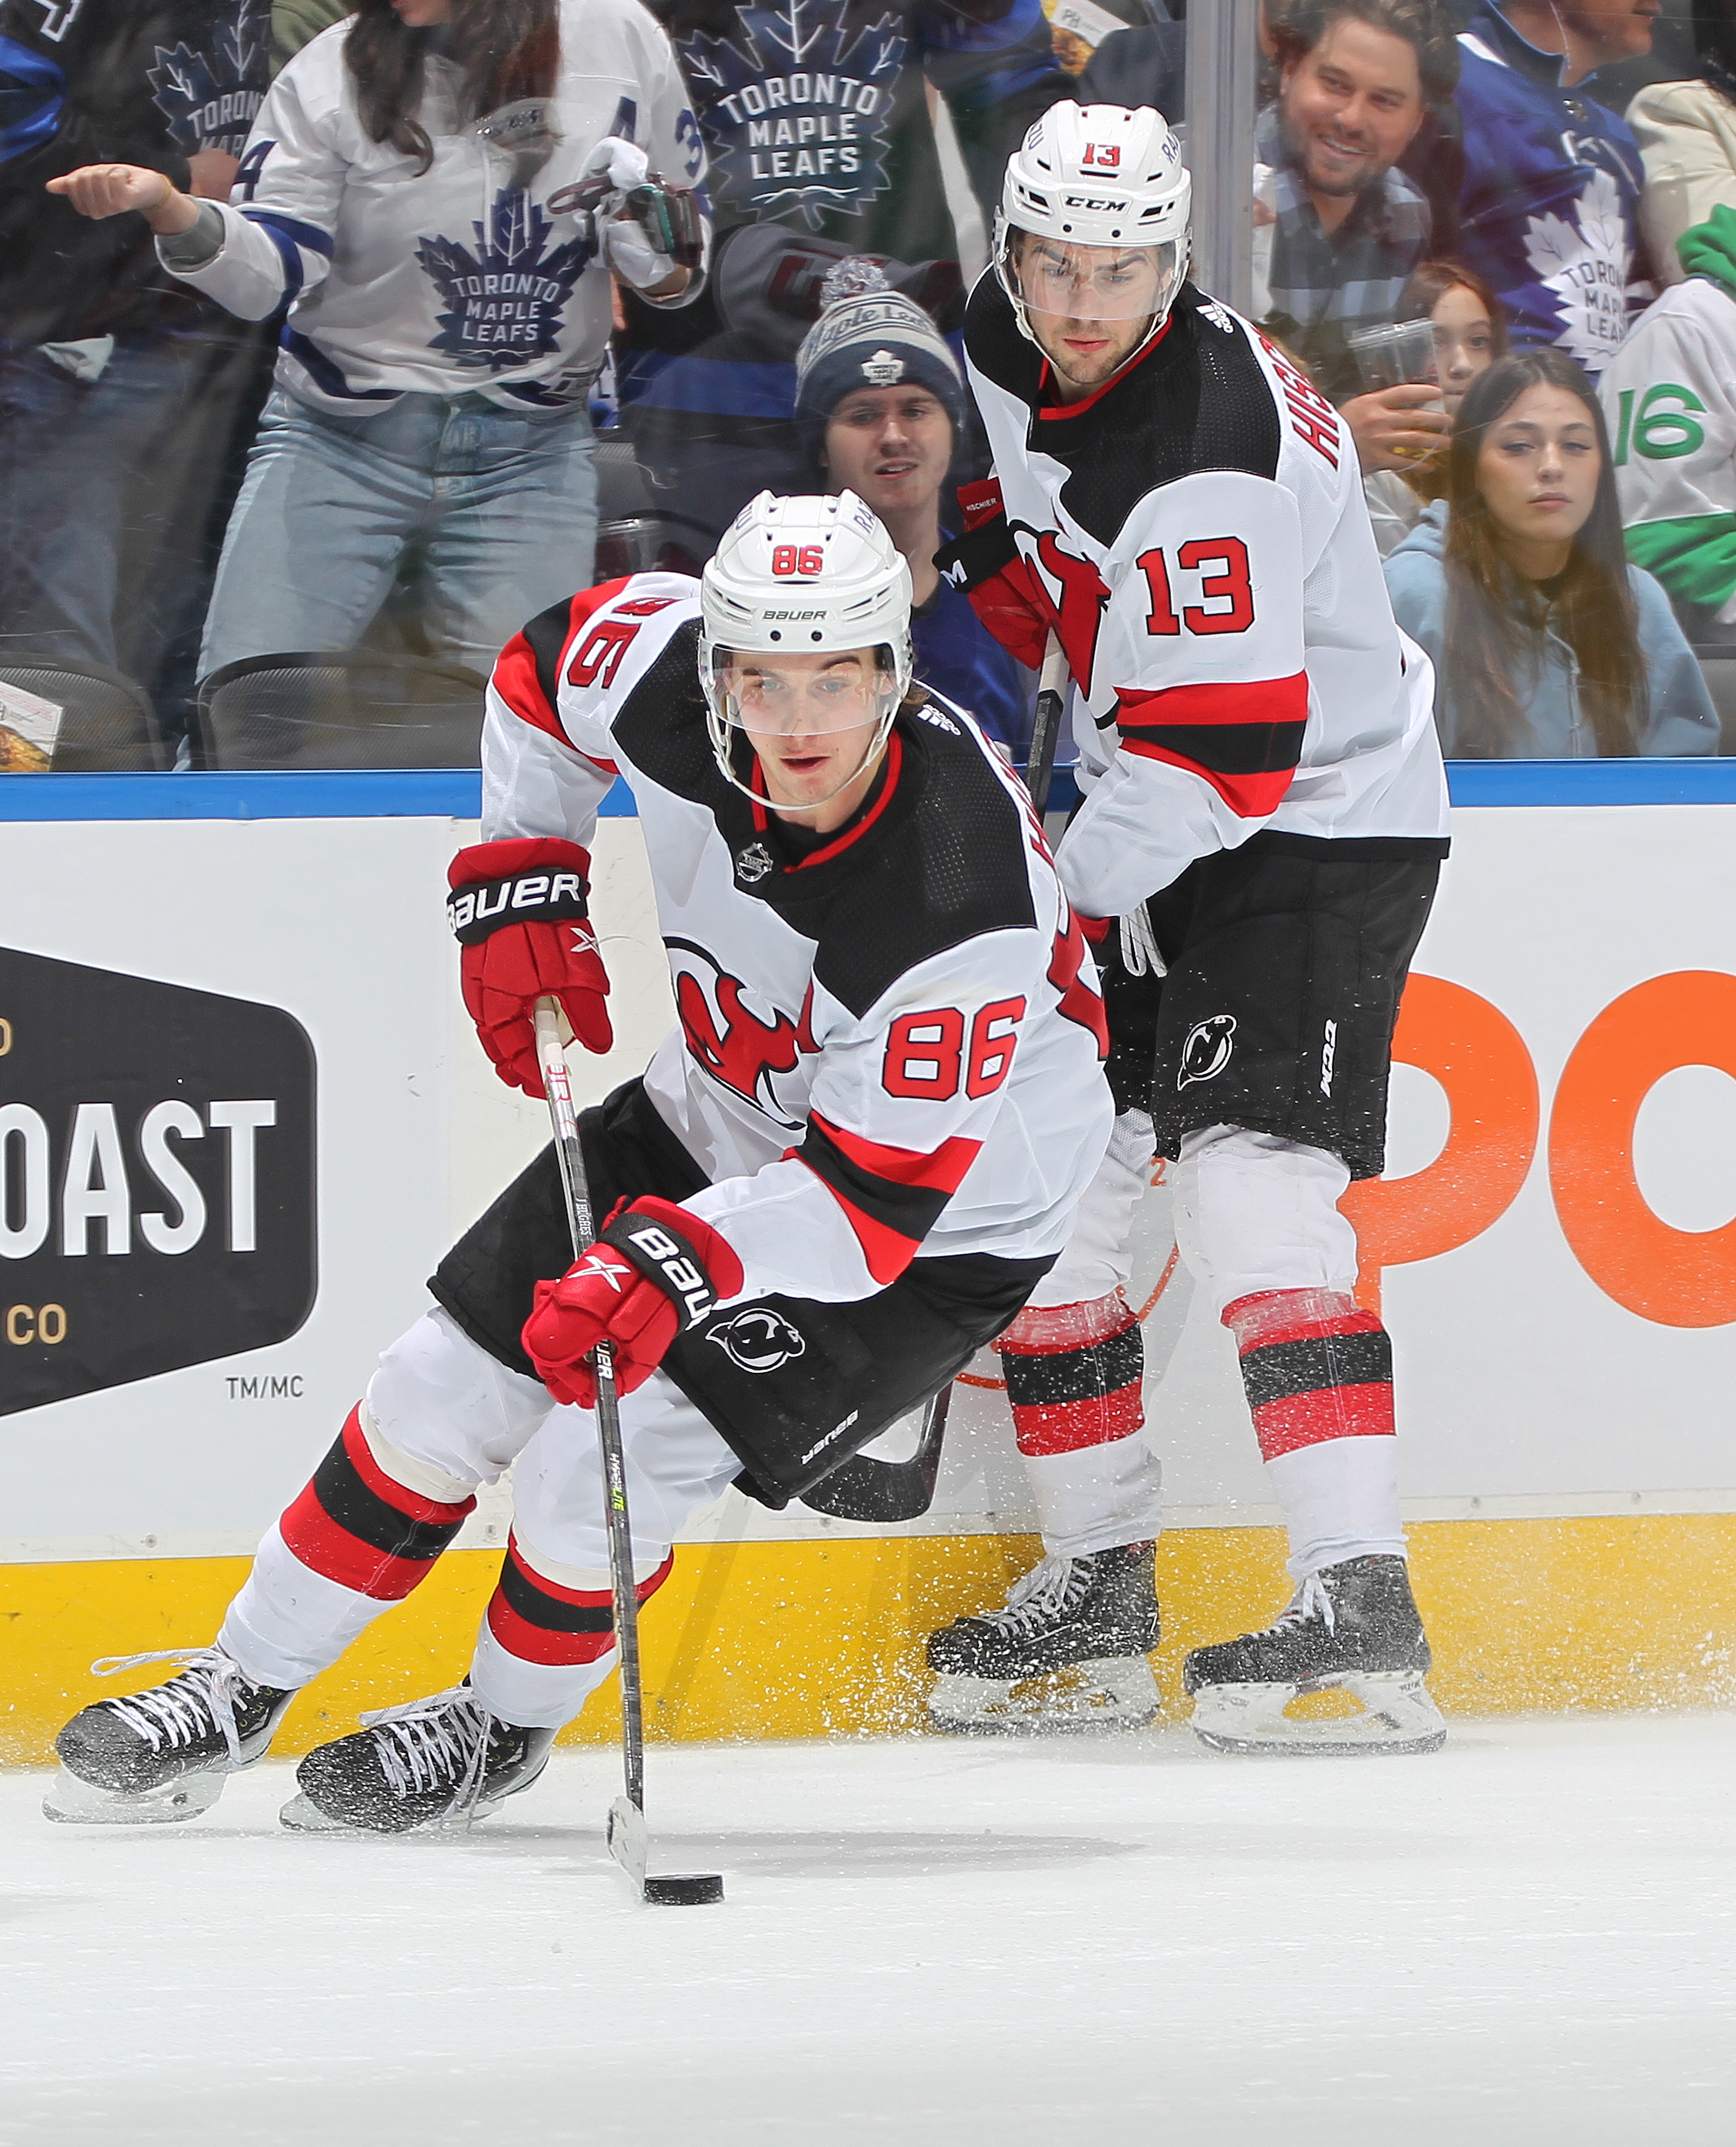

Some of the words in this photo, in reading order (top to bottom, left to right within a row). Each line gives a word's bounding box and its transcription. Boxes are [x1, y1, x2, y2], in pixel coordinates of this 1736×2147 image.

[187, 91, 265, 138] TORON
[717, 73, 878, 123] TORONTO
[748, 113, 858, 147] MAPLE
[750, 146, 860, 180] LEAFS
[1082, 143, 1120, 166] 13
[1064, 196, 1129, 212] CCM
[450, 273, 560, 302] TORONTO
[466, 298, 542, 320] MAPLE
[462, 321, 539, 342] LEAFS
[1614, 383, 1708, 466] 16
[772, 545, 823, 575] 86
[1135, 535, 1255, 636] 13
[763, 610, 828, 621] BAUER
[882, 994, 1026, 1101] 86
[1320, 1019, 1337, 1098] CCM
[0, 1099, 276, 1259] OAST
[576, 1203, 592, 1235] HUGHES
[627, 1227, 712, 1330] BAU
[7, 1303, 67, 1345] CO
[225, 1375, 303, 1399] TM/MC
